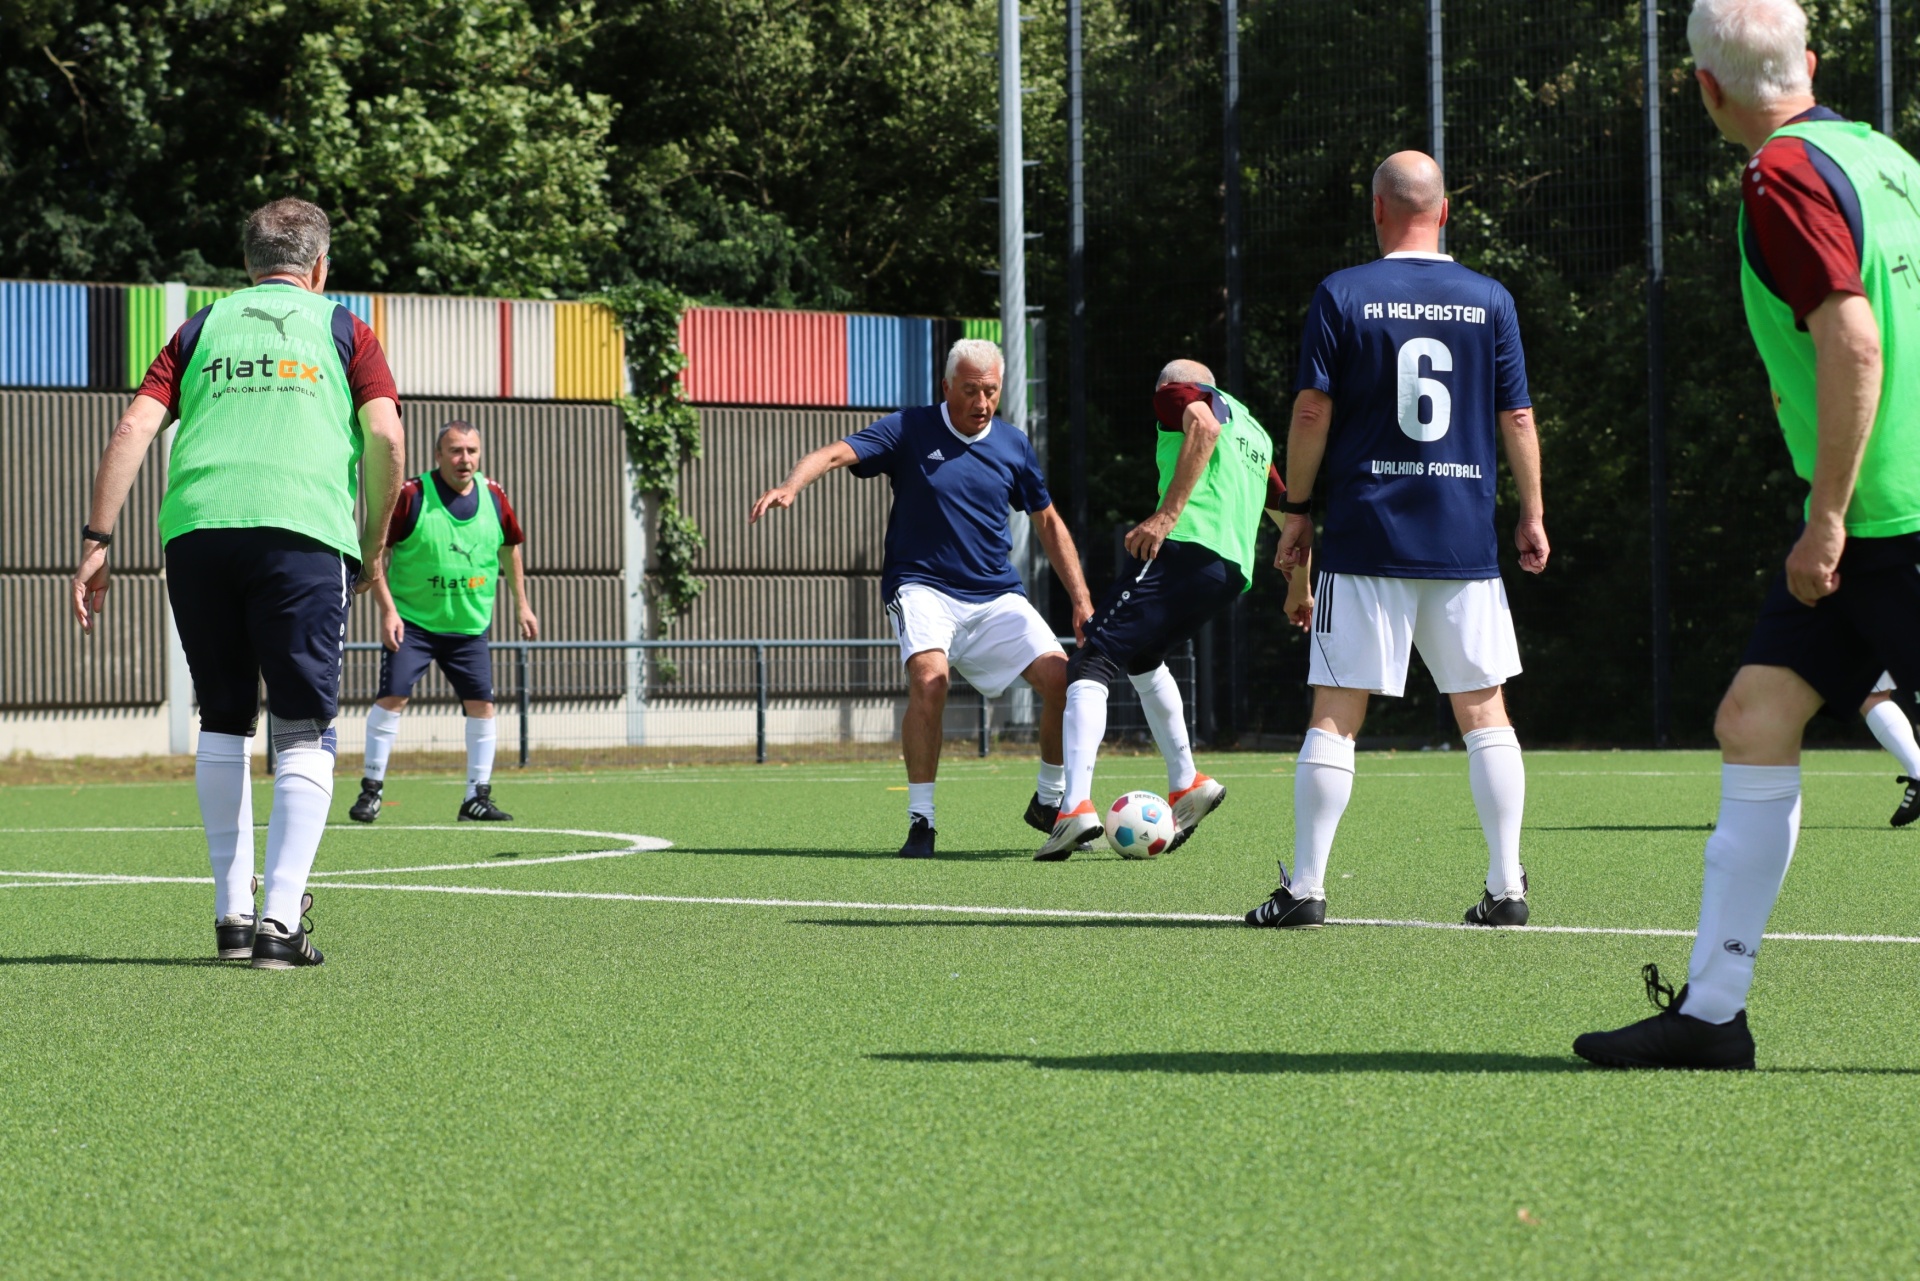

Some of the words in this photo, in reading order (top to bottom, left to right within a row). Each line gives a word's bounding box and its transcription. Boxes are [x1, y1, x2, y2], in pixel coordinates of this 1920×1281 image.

[1363, 302, 1384, 320] FK
[1387, 302, 1486, 324] HELPENSTEIN
[1397, 337, 1453, 442] 6
[1236, 437, 1269, 473] flat
[1371, 460, 1425, 476] WALKING
[1428, 462, 1482, 479] FOOTBALL
